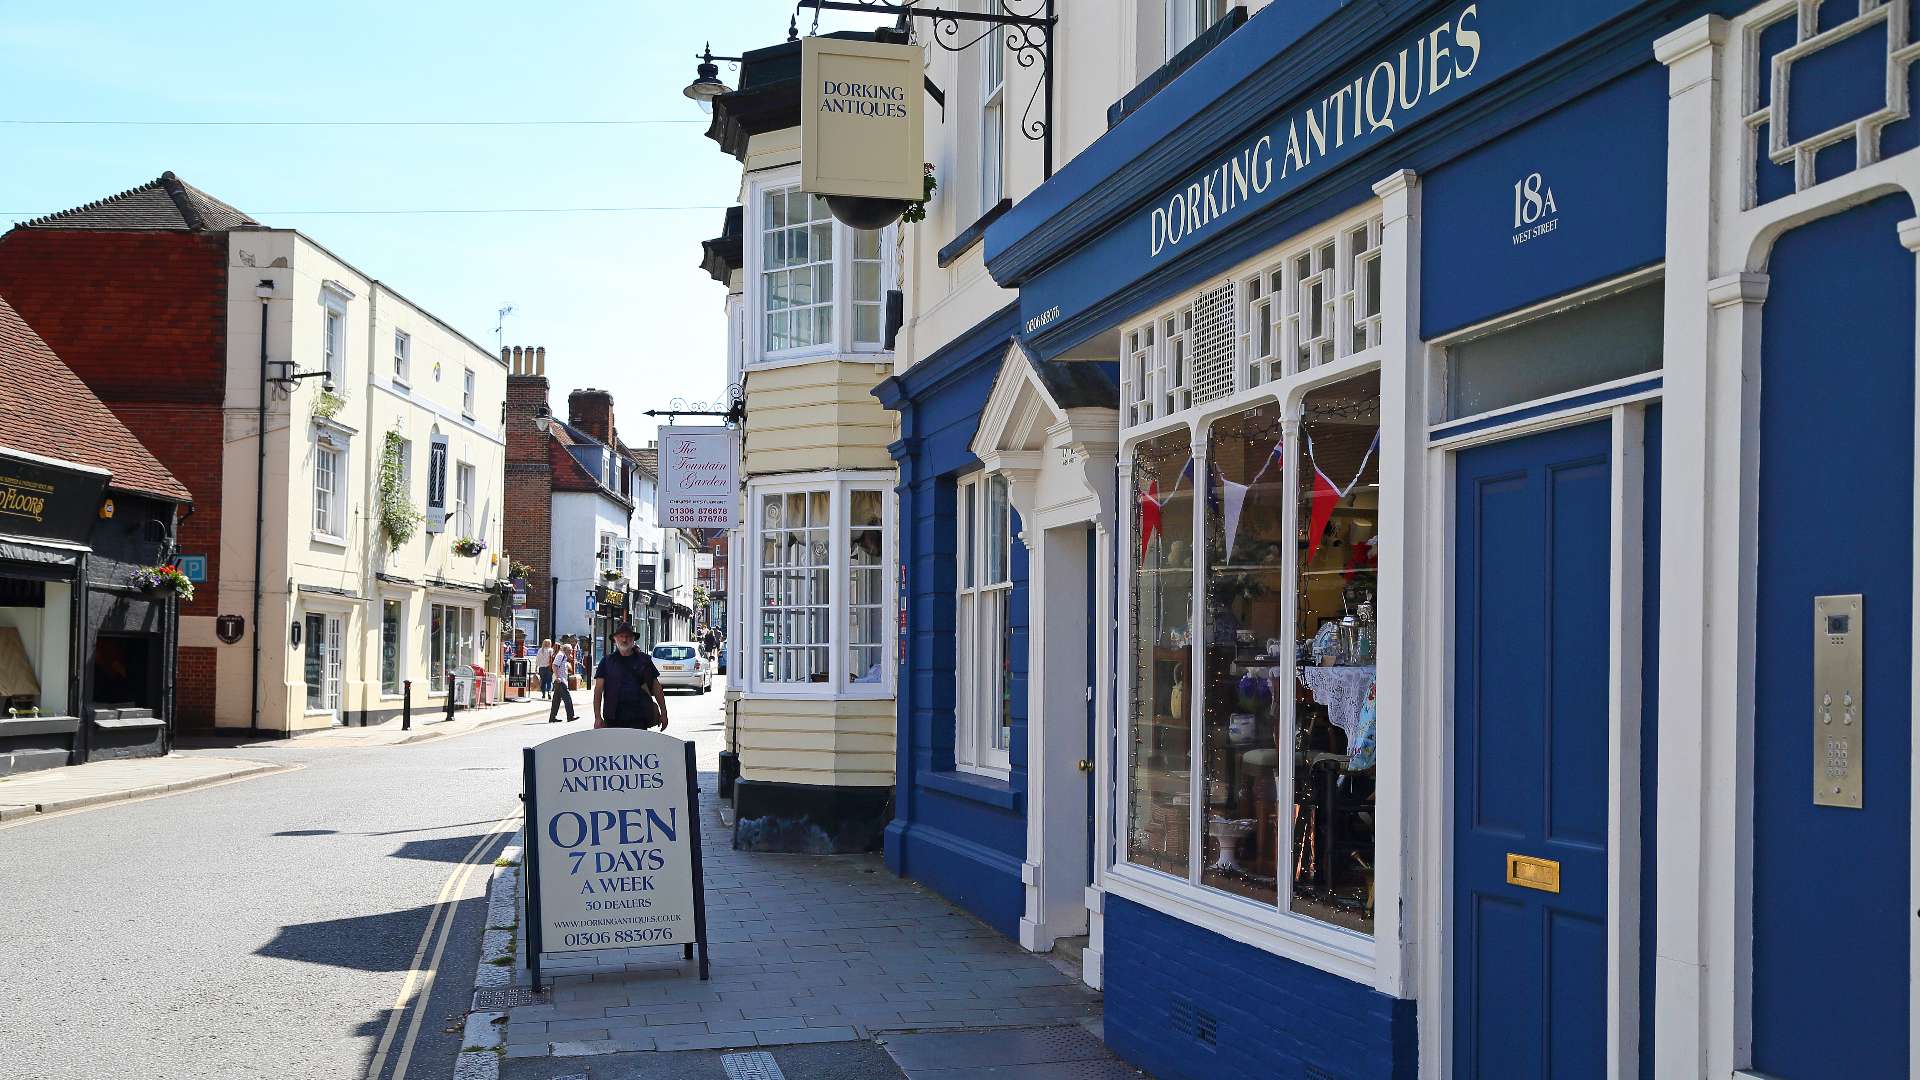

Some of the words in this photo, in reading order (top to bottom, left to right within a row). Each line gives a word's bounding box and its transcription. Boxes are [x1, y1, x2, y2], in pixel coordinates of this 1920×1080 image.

[824, 81, 904, 101] DORKING
[820, 98, 907, 118] ANTIQUES
[1151, 136, 1273, 257] DORKING
[1280, 4, 1481, 180] ANTIQUES
[1513, 172, 1557, 228] 18A
[1513, 229, 1533, 245] WEST
[1532, 218, 1558, 238] STREET
[673, 440, 697, 454] The
[673, 457, 727, 470] Fountain
[680, 472, 727, 489] Garden
[190, 562, 199, 573] P
[562, 753, 660, 773] DORKING
[560, 772, 664, 792] ANTIQUES
[548, 808, 677, 849] OPEN
[569, 851, 585, 876] 7
[595, 849, 665, 873] DAYS
[581, 880, 595, 894] A
[599, 876, 654, 894] WEEK
[586, 900, 601, 911] 30
[604, 899, 652, 910] DEALERS
[554, 914, 681, 929] WWW.DORKINGANTIQUES.CO.UK
[564, 931, 610, 947] 01306
[615, 928, 672, 944] 883076
